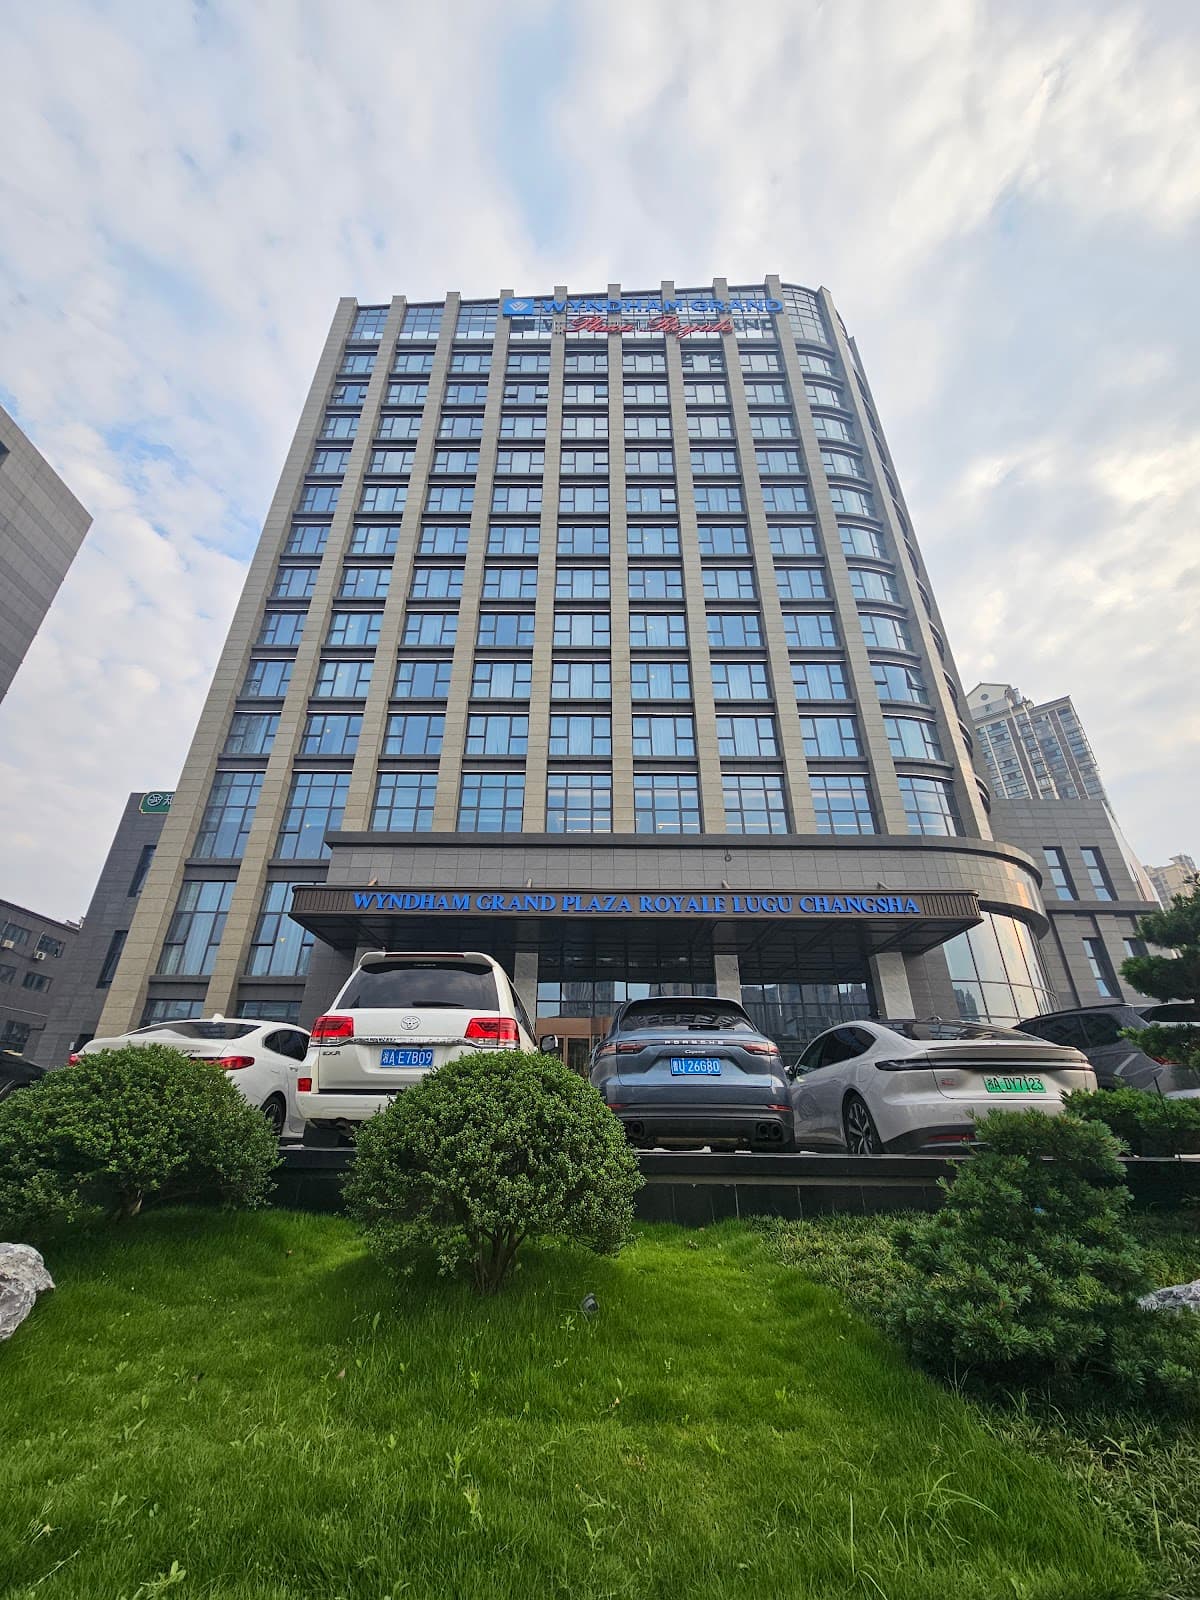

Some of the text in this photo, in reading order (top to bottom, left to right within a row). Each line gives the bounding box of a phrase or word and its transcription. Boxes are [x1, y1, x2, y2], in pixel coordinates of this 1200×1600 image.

[542, 299, 784, 314] WYNDHAM GRAND
[352, 892, 920, 913] WYNDHAM GRAND PLAZA ROYALE LUGU CHANGSHA
